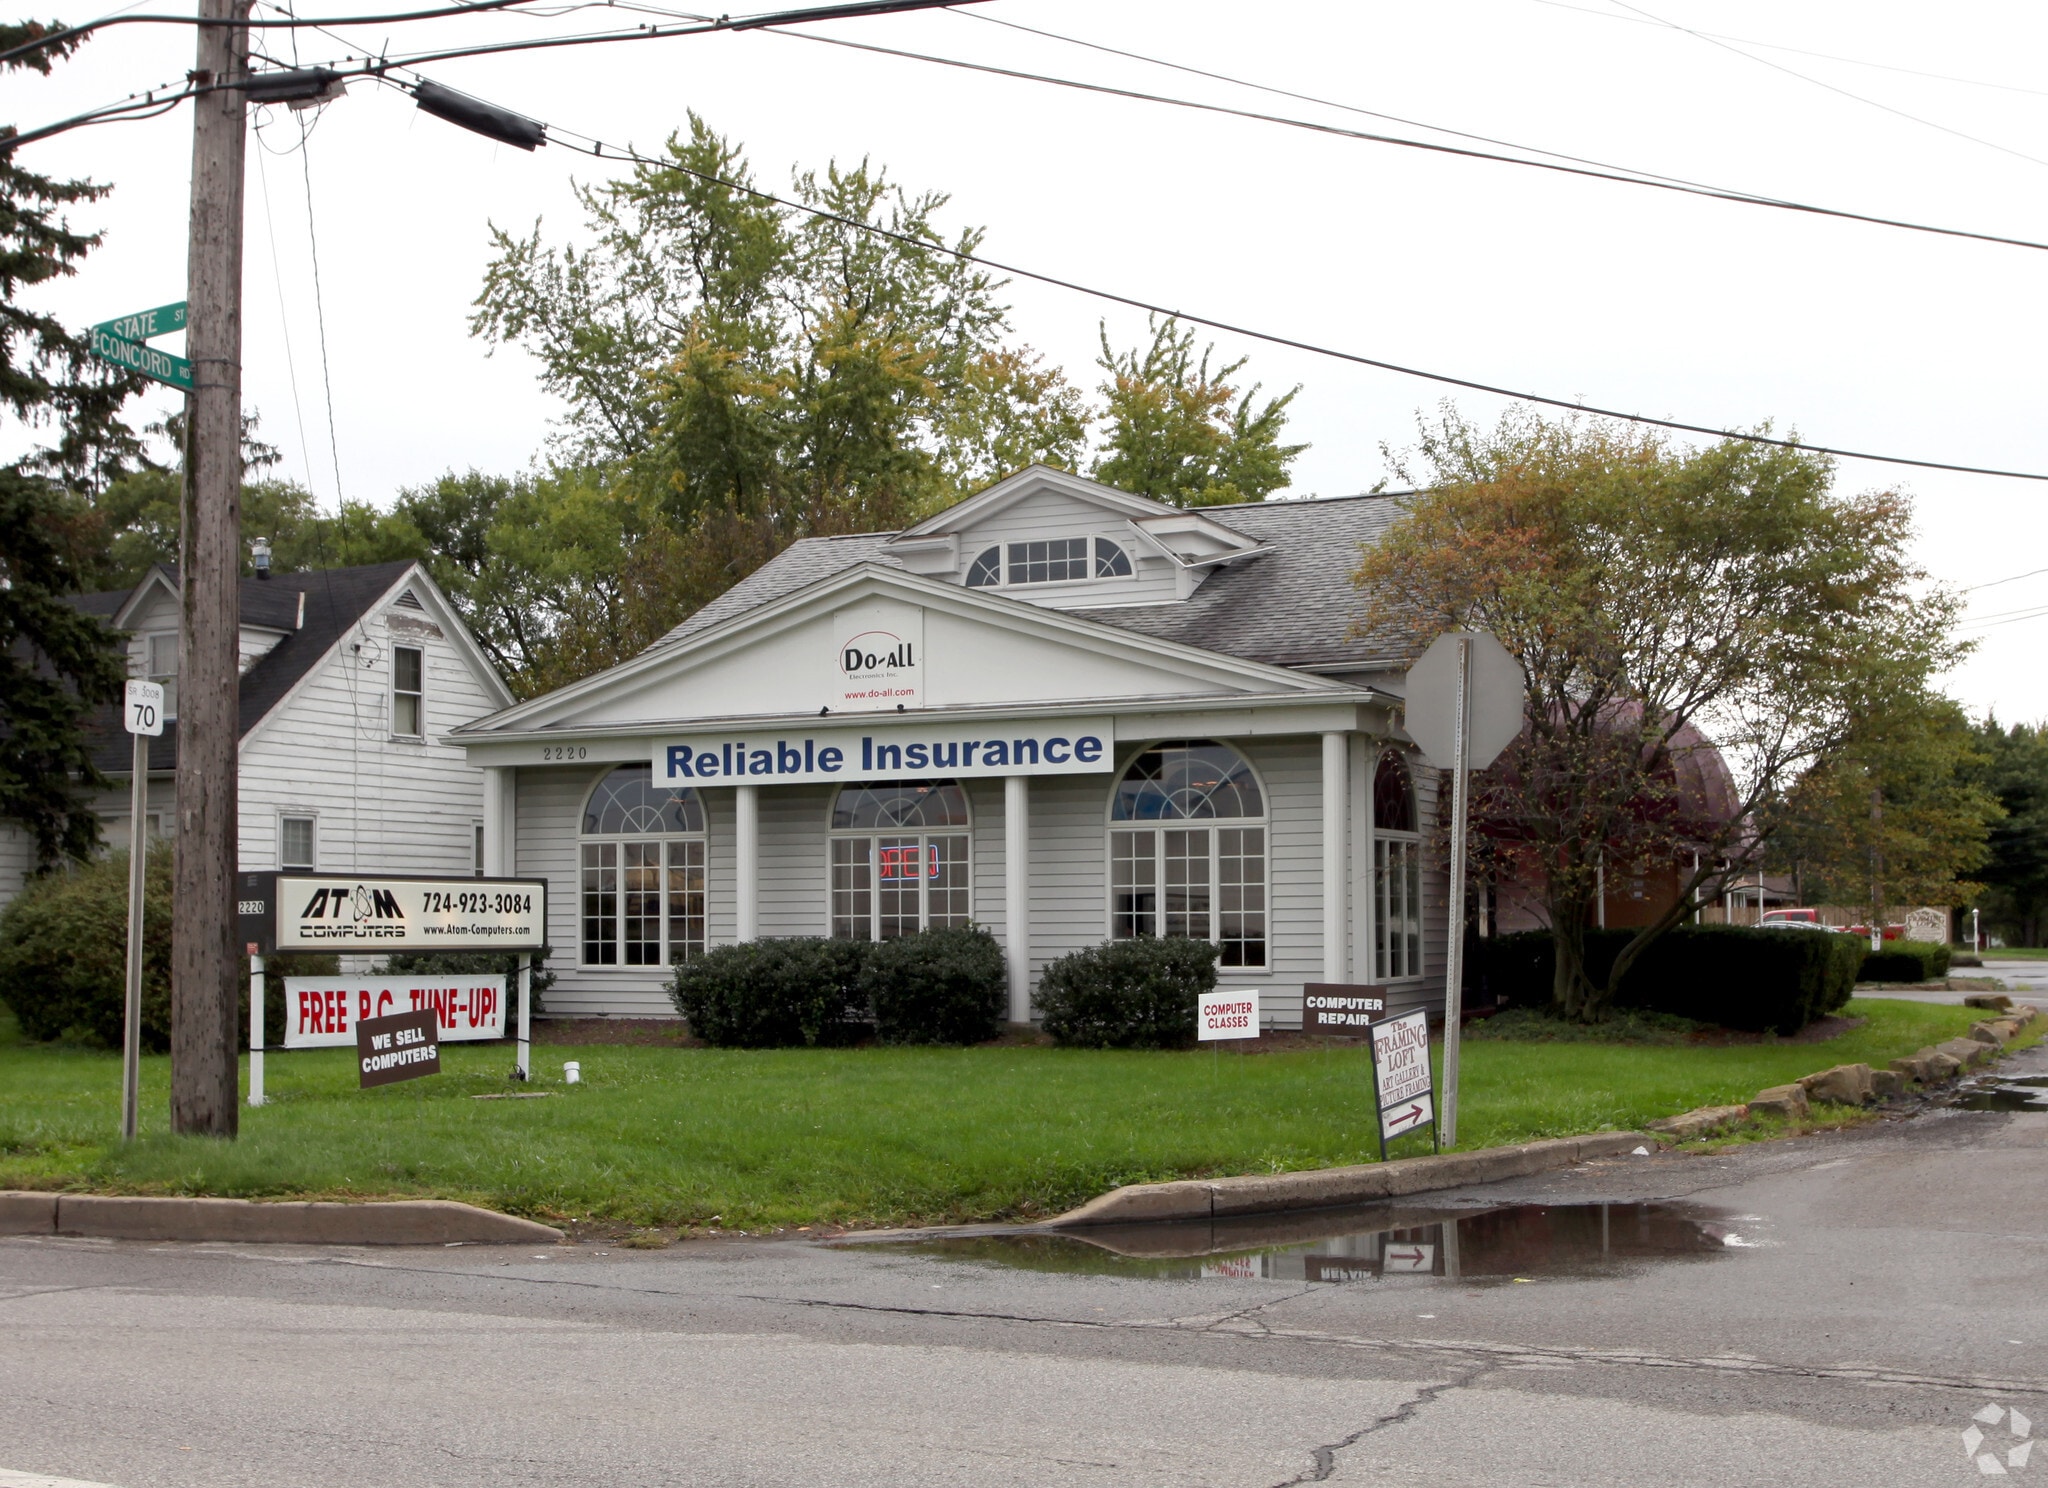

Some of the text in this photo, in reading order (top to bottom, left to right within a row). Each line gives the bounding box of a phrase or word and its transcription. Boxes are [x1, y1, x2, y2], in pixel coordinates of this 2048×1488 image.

[114, 311, 157, 340] STATE
[174, 308, 184, 322] ST
[100, 333, 190, 379] CONCORD RD
[128, 686, 160, 699] SR 3008
[844, 688, 915, 699] www.do-all.com
[133, 704, 155, 727] 70
[544, 747, 587, 760] 2220
[667, 736, 1103, 778] Reliable Insurance
[239, 902, 263, 913] 2220
[300, 885, 531, 922] ATOM 724-923-3084
[300, 924, 531, 938] COMPUTERS www.Atom-Computers.com
[298, 991, 347, 1034] FREE
[1204, 1002, 1253, 1017] COMPUTER
[1306, 996, 1383, 1011] COMPUTER
[1208, 1016, 1249, 1029] CLASSES
[1318, 1012, 1369, 1026] REPAIR
[1391, 1021, 1408, 1033] The
[371, 1027, 426, 1050] WE SELL
[1374, 1024, 1427, 1064] FRAMING
[362, 1045, 437, 1073] COMPUTERS
[1388, 1046, 1416, 1072] LOFT
[1382, 1076, 1393, 1091] ART
[1394, 1065, 1420, 1086] GALLERY
[1405, 1076, 1431, 1098] FRAMING
